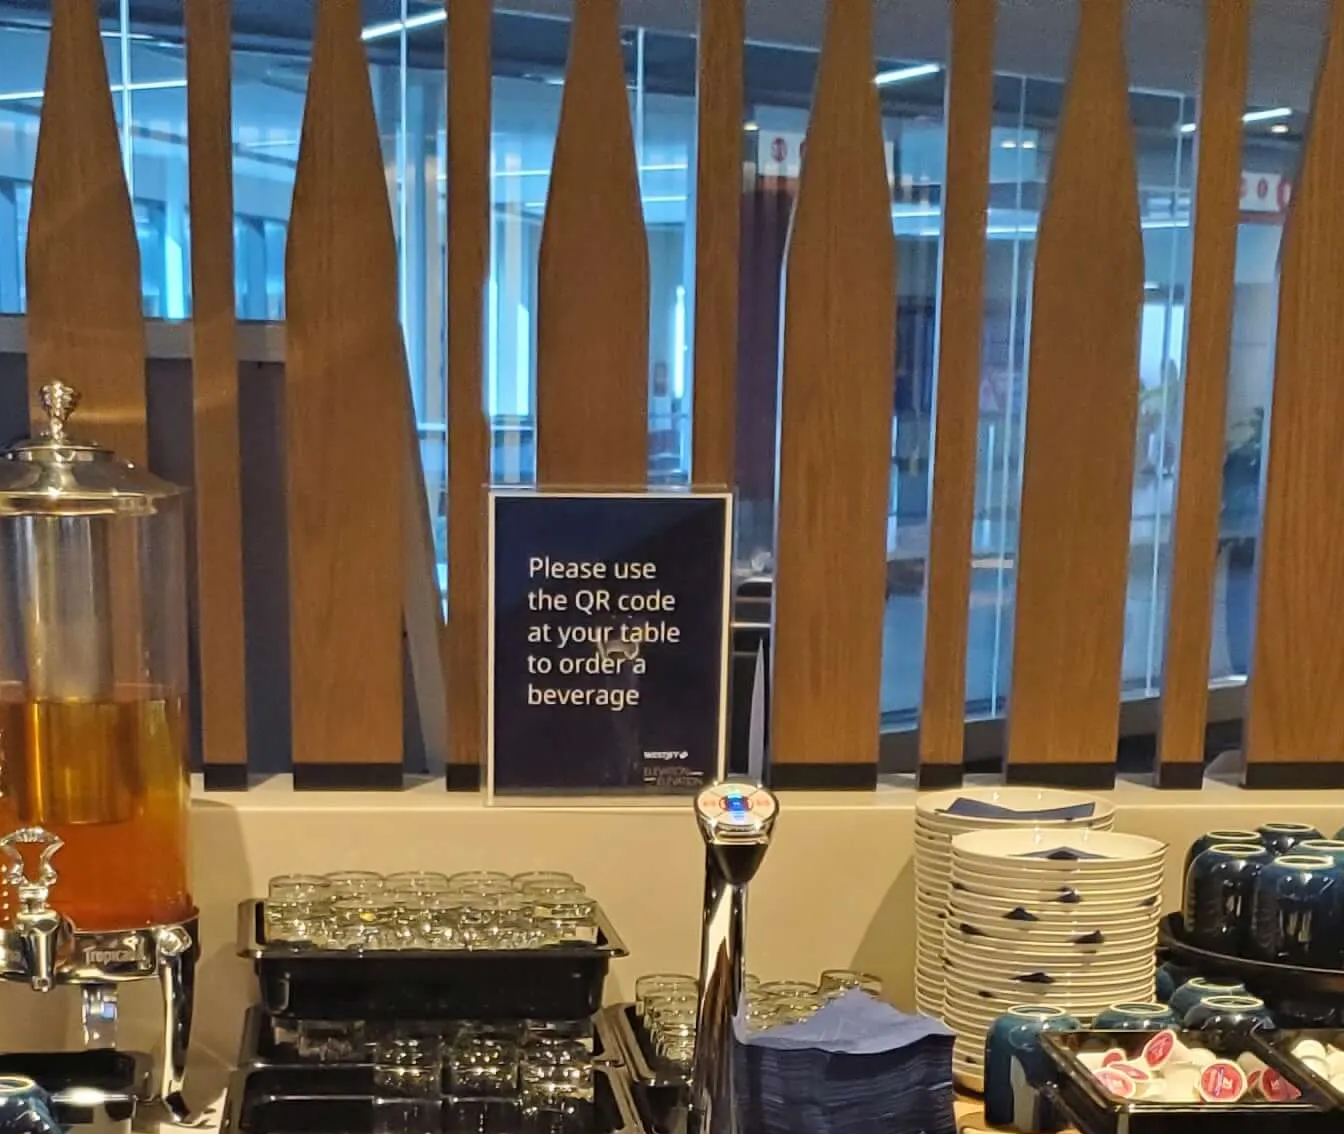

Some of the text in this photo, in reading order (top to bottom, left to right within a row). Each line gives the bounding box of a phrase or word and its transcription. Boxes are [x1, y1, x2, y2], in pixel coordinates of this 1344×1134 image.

[529, 557, 657, 579] Please use
[528, 589, 676, 614] the QR code
[528, 621, 681, 648] at your table
[528, 652, 646, 674] to order a
[528, 683, 640, 711] beverage
